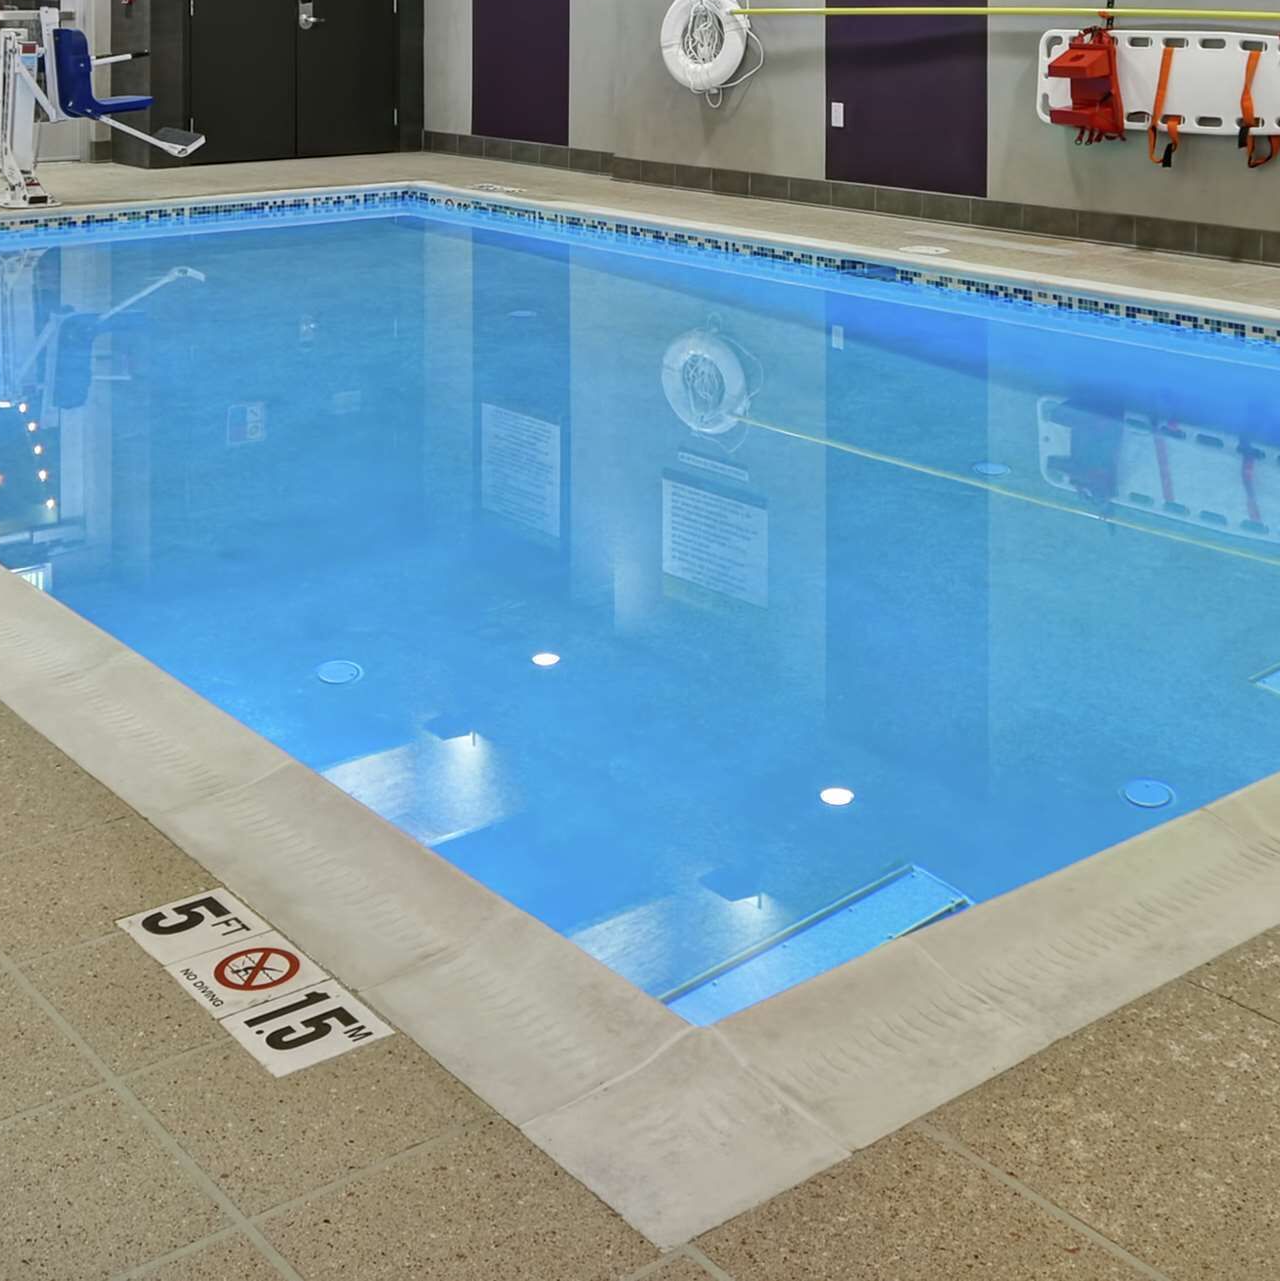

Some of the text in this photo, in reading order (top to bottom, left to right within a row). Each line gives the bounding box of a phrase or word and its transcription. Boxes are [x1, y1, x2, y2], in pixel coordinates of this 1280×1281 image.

[141, 896, 251, 936] 5 FT
[180, 969, 224, 1007] NO DIVING
[243, 990, 374, 1051] 1.5 M
